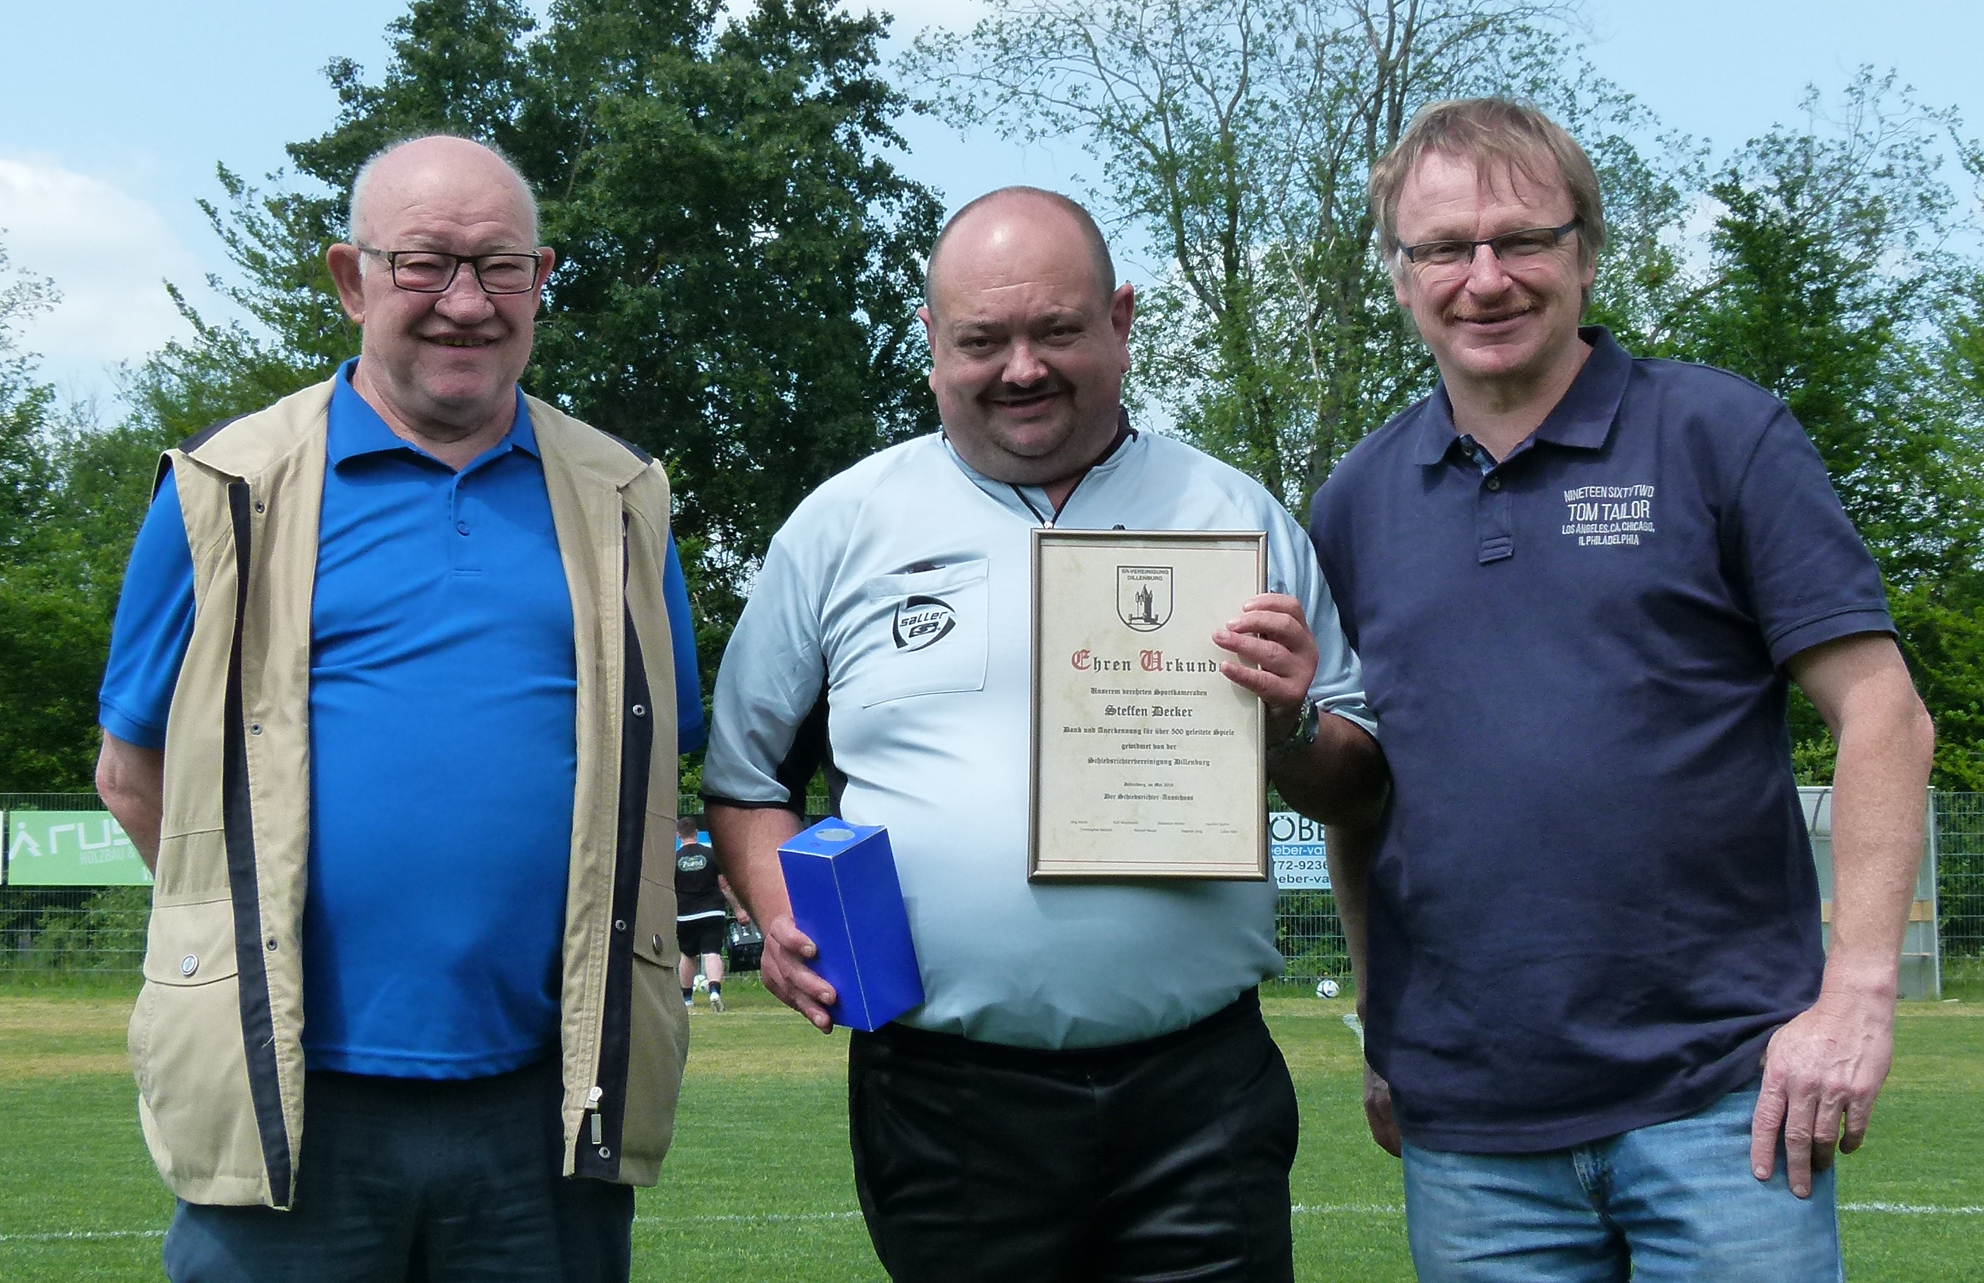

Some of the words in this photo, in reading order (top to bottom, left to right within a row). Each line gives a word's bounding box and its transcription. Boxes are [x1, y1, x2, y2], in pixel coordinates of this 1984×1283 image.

[1564, 485, 1607, 502] NINETEEN
[1567, 503, 1598, 521] TOM
[1602, 500, 1650, 520] TAILOR
[1562, 524, 1575, 535] LOS
[1578, 535, 1586, 546] IL
[1586, 534, 1639, 546] PHILADELPHIA
[1071, 649, 1131, 673] Ehren
[1139, 649, 1221, 672] Urkund
[1154, 689, 1207, 697] Sportkameraden
[1104, 704, 1148, 716] Steffen
[1151, 705, 1193, 718] Decker
[1063, 726, 1082, 734] Dank
[1097, 726, 1142, 735] Anerkennung
[1174, 758, 1210, 767] Dillenburg
